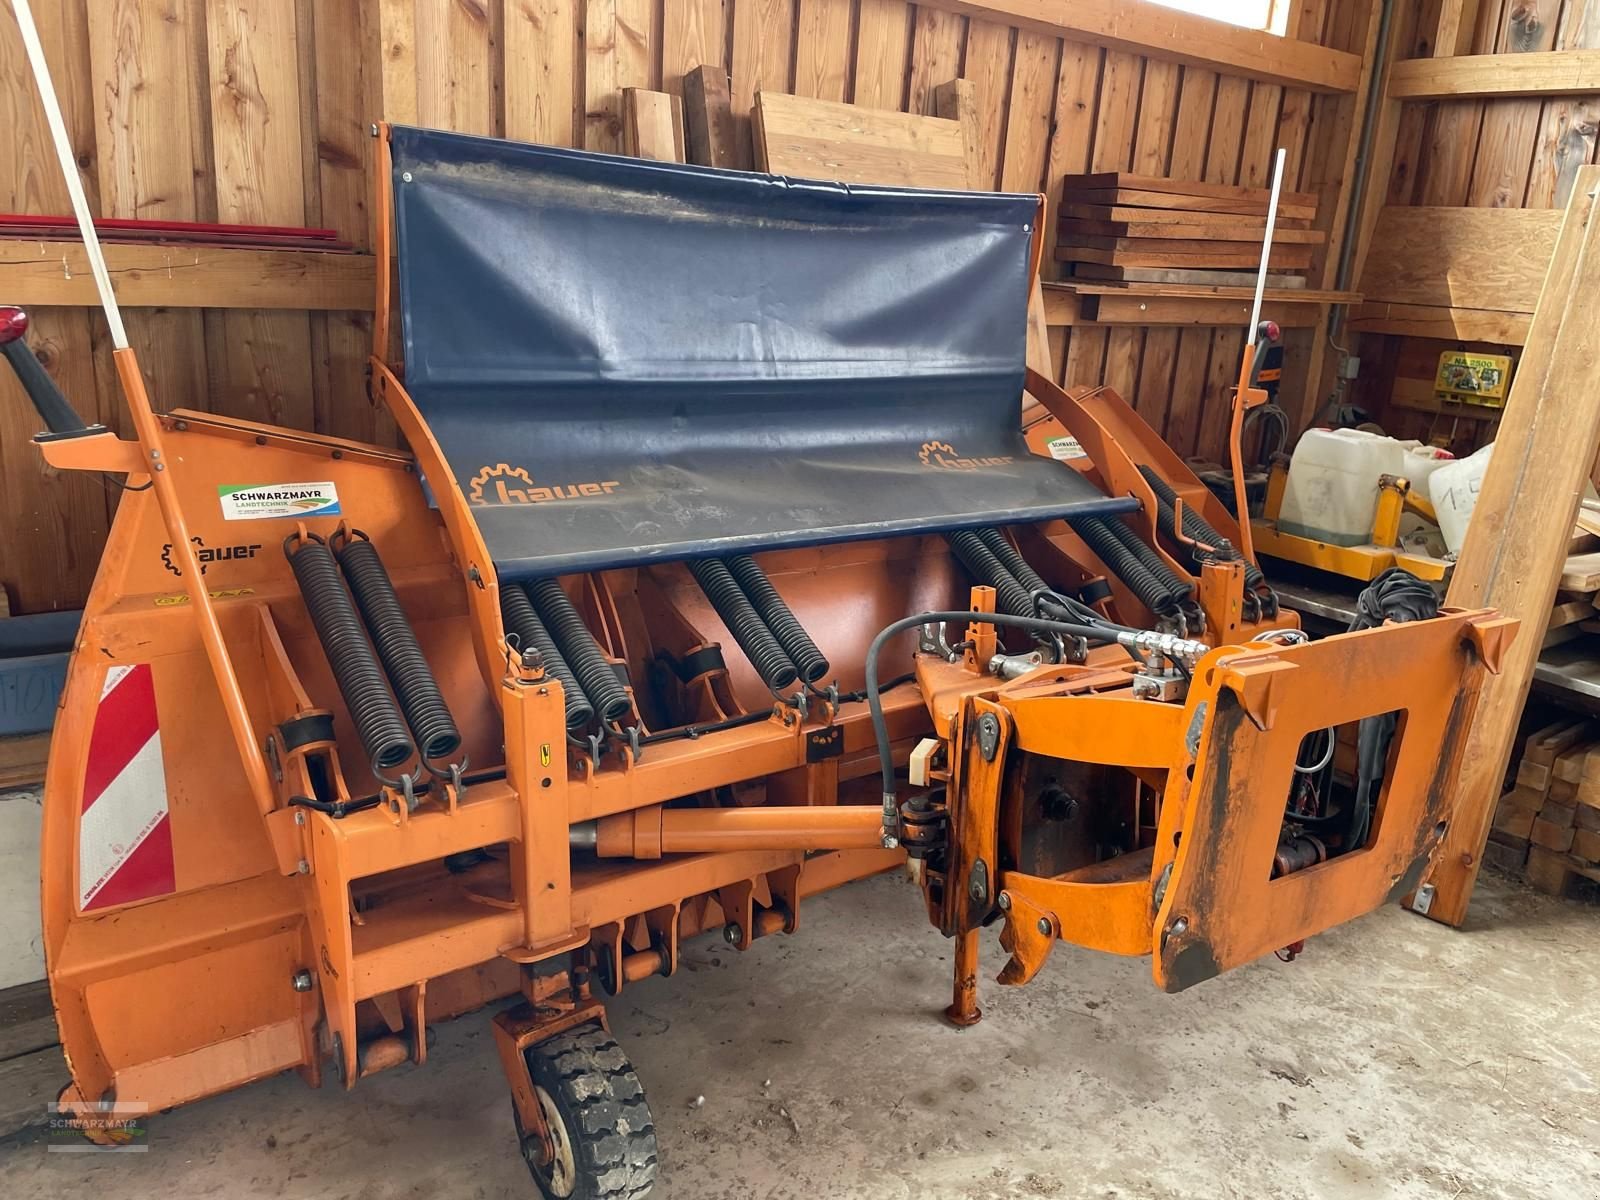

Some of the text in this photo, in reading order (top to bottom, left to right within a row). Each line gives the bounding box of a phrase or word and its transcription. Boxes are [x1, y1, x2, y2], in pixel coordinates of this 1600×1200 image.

[934, 453, 1014, 470] hauer
[232, 490, 322, 501] SCHWARZMAYR
[495, 480, 620, 505] hauer
[194, 544, 262, 562] auer
